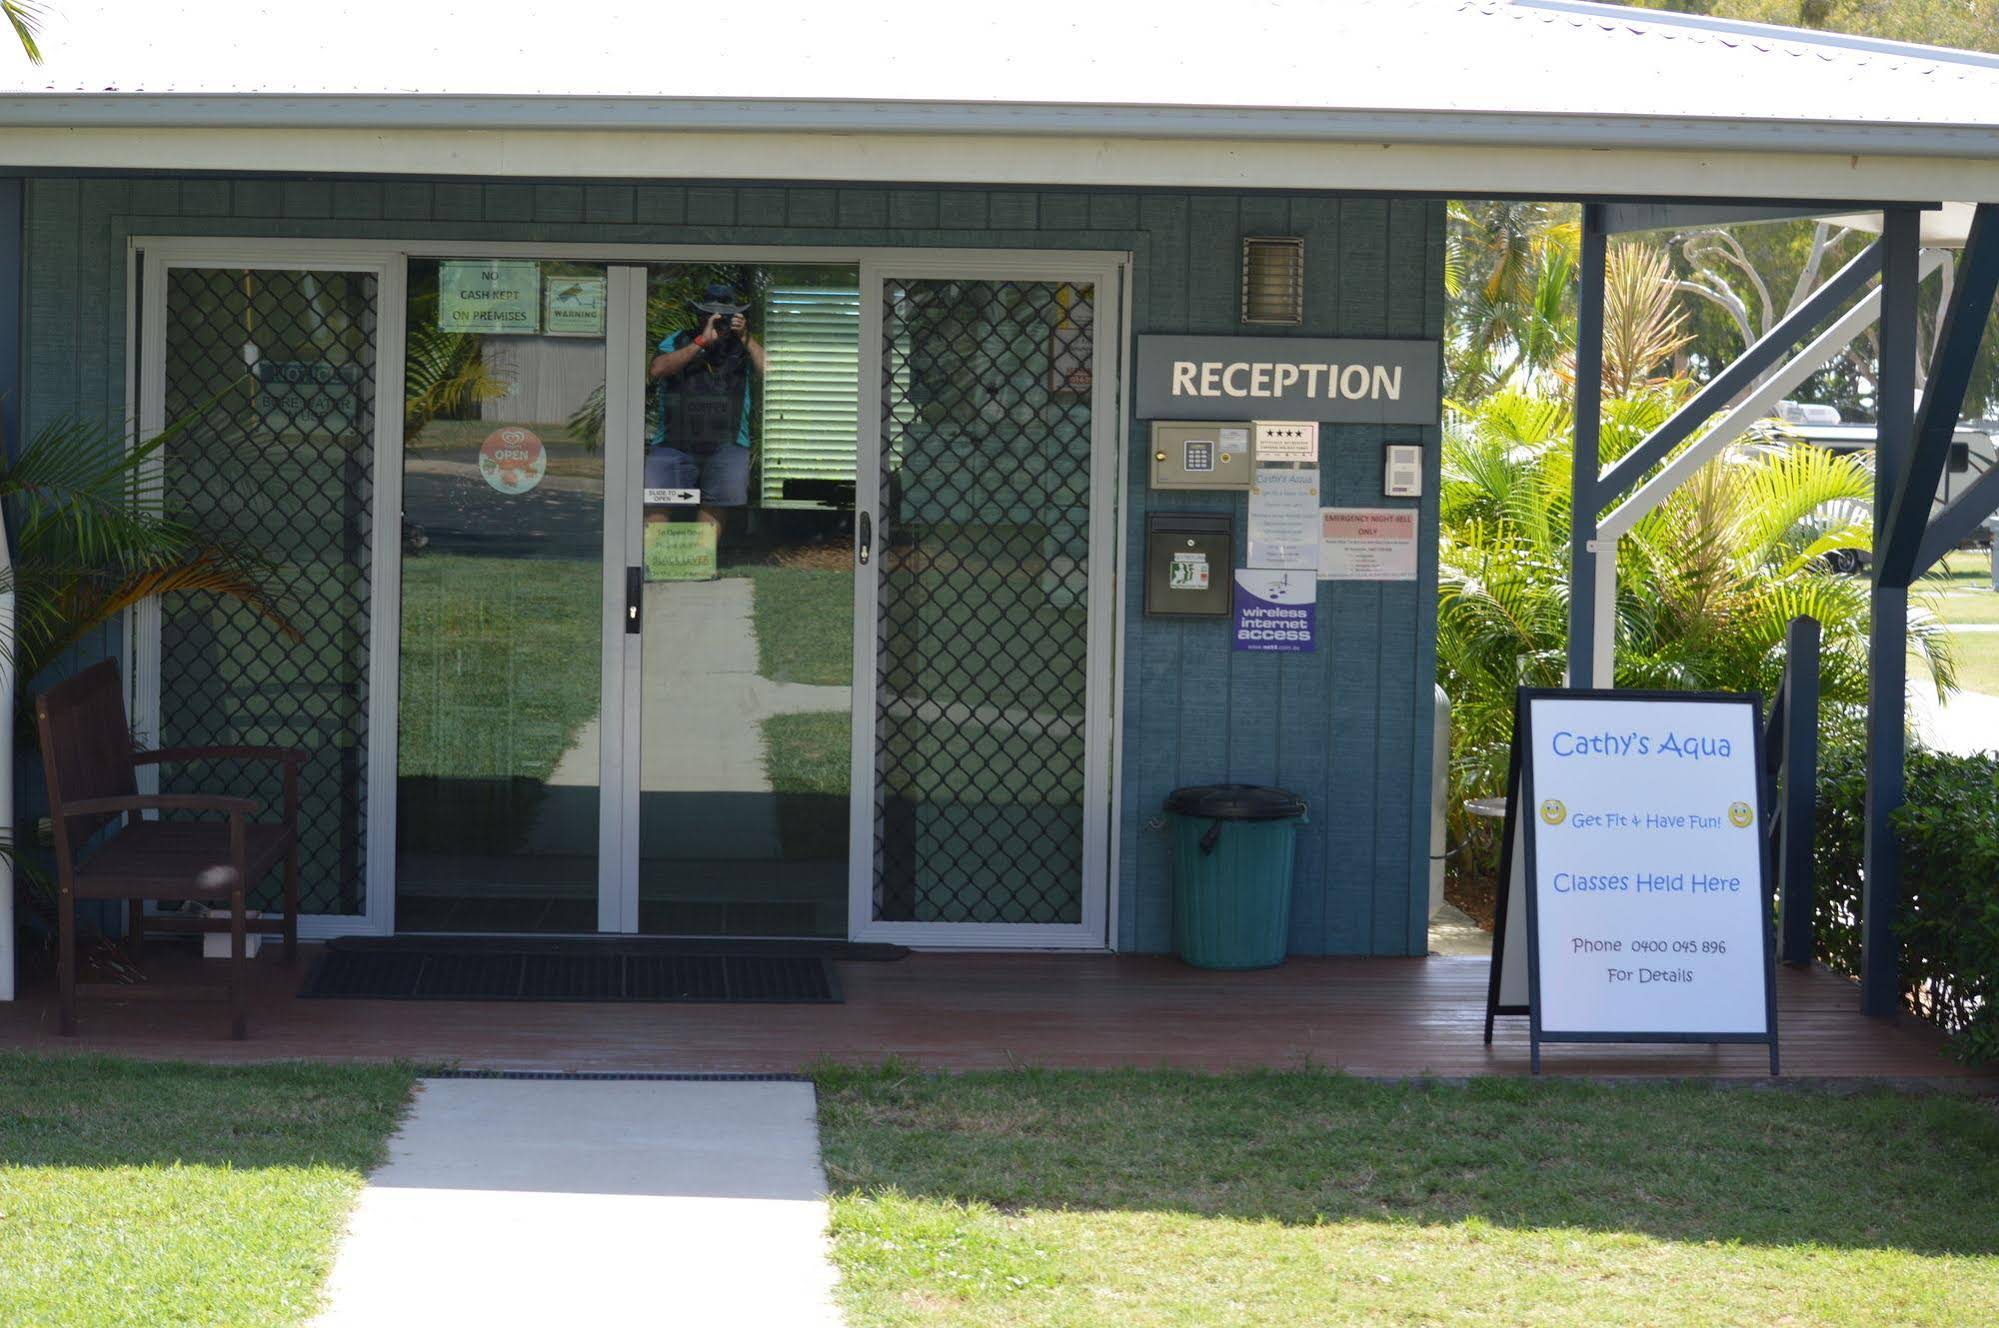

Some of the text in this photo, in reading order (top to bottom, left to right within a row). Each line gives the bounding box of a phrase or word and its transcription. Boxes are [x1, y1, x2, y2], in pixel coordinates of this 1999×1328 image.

[481, 271, 499, 281] NO
[460, 290, 520, 300] CASH KEPT
[452, 311, 527, 321] ON PREMISES
[554, 310, 597, 319] WARNING
[1171, 361, 1402, 400] RECEPTION
[495, 449, 529, 461] OPEN
[1324, 514, 1369, 522] EMERGENCY
[1242, 606, 1308, 618] wireless
[1241, 617, 1308, 629] internet
[1237, 629, 1311, 641] access
[1552, 731, 1731, 760] Cathy's Aqua
[1572, 813, 1602, 829] Get
[1605, 813, 1628, 829] Fit
[1646, 814, 1685, 829] Have
[1688, 814, 1721, 829] Fun!
[1553, 872, 1741, 893] Classes Held Here
[1571, 937, 1727, 954] Phone 0400 045 896
[1608, 967, 1693, 983] For Details
